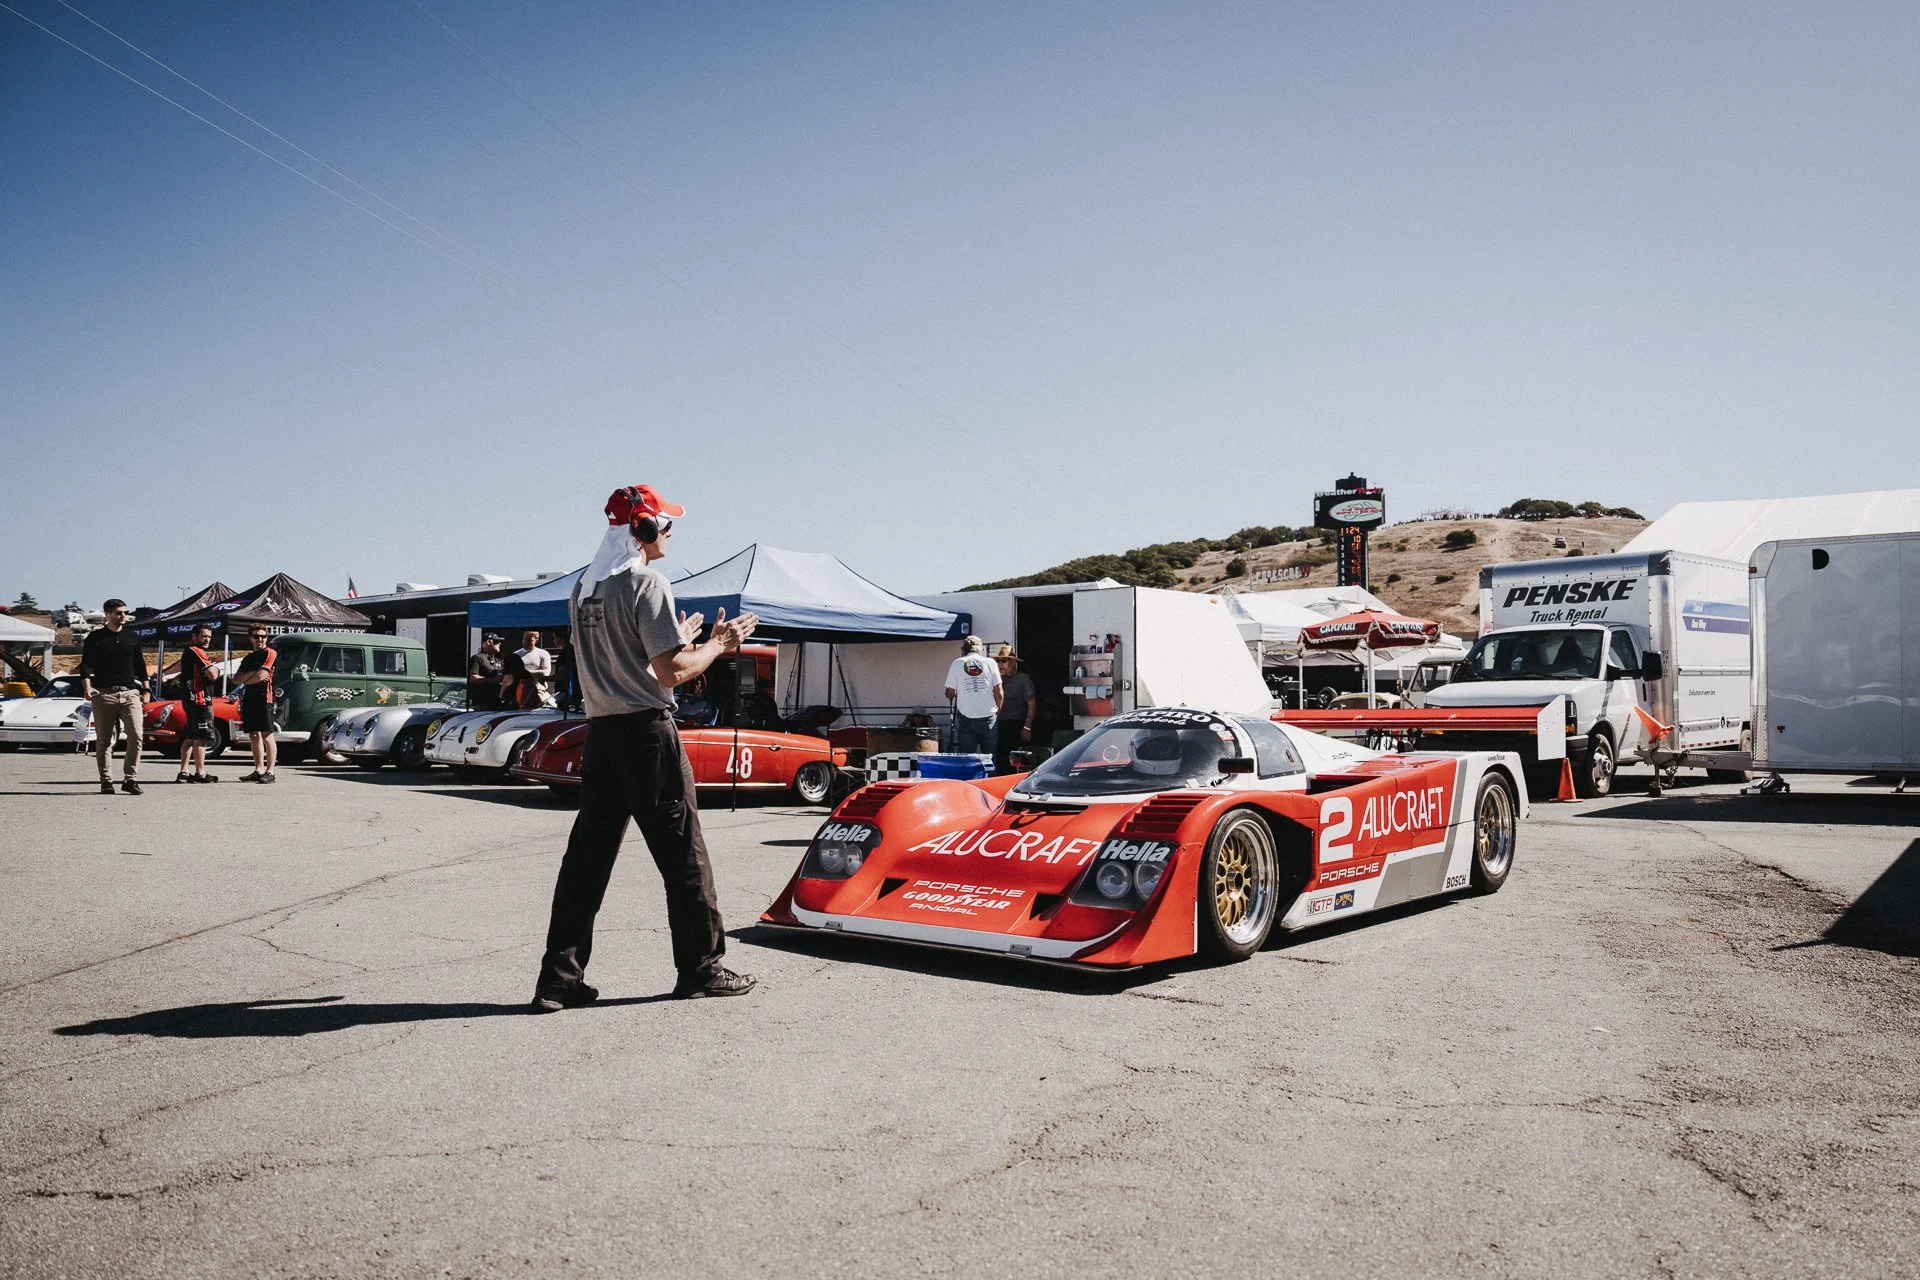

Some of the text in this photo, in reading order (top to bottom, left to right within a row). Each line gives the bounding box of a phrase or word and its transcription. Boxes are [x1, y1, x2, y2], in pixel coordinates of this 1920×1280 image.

[1502, 578, 1638, 608] PENSKE
[1530, 607, 1609, 623] Truck Rental
[266, 625, 286, 635] THE
[288, 626, 330, 634] RACING
[1320, 623, 1357, 634] CAMPARI
[725, 746, 753, 779] 48
[1357, 786, 1444, 842] ALUCRAFT
[817, 823, 872, 842] Hella
[1319, 796, 1354, 864] 2
[906, 829, 1103, 867] ALUCRAFT
[1100, 839, 1171, 862] Hella
[1319, 861, 1380, 884] PORSCHE
[1445, 873, 1467, 889] BOSCH
[913, 879, 1026, 898] PORSCHE
[902, 891, 1011, 910] GOODYEAR
[908, 902, 978, 916] ANDIAL
